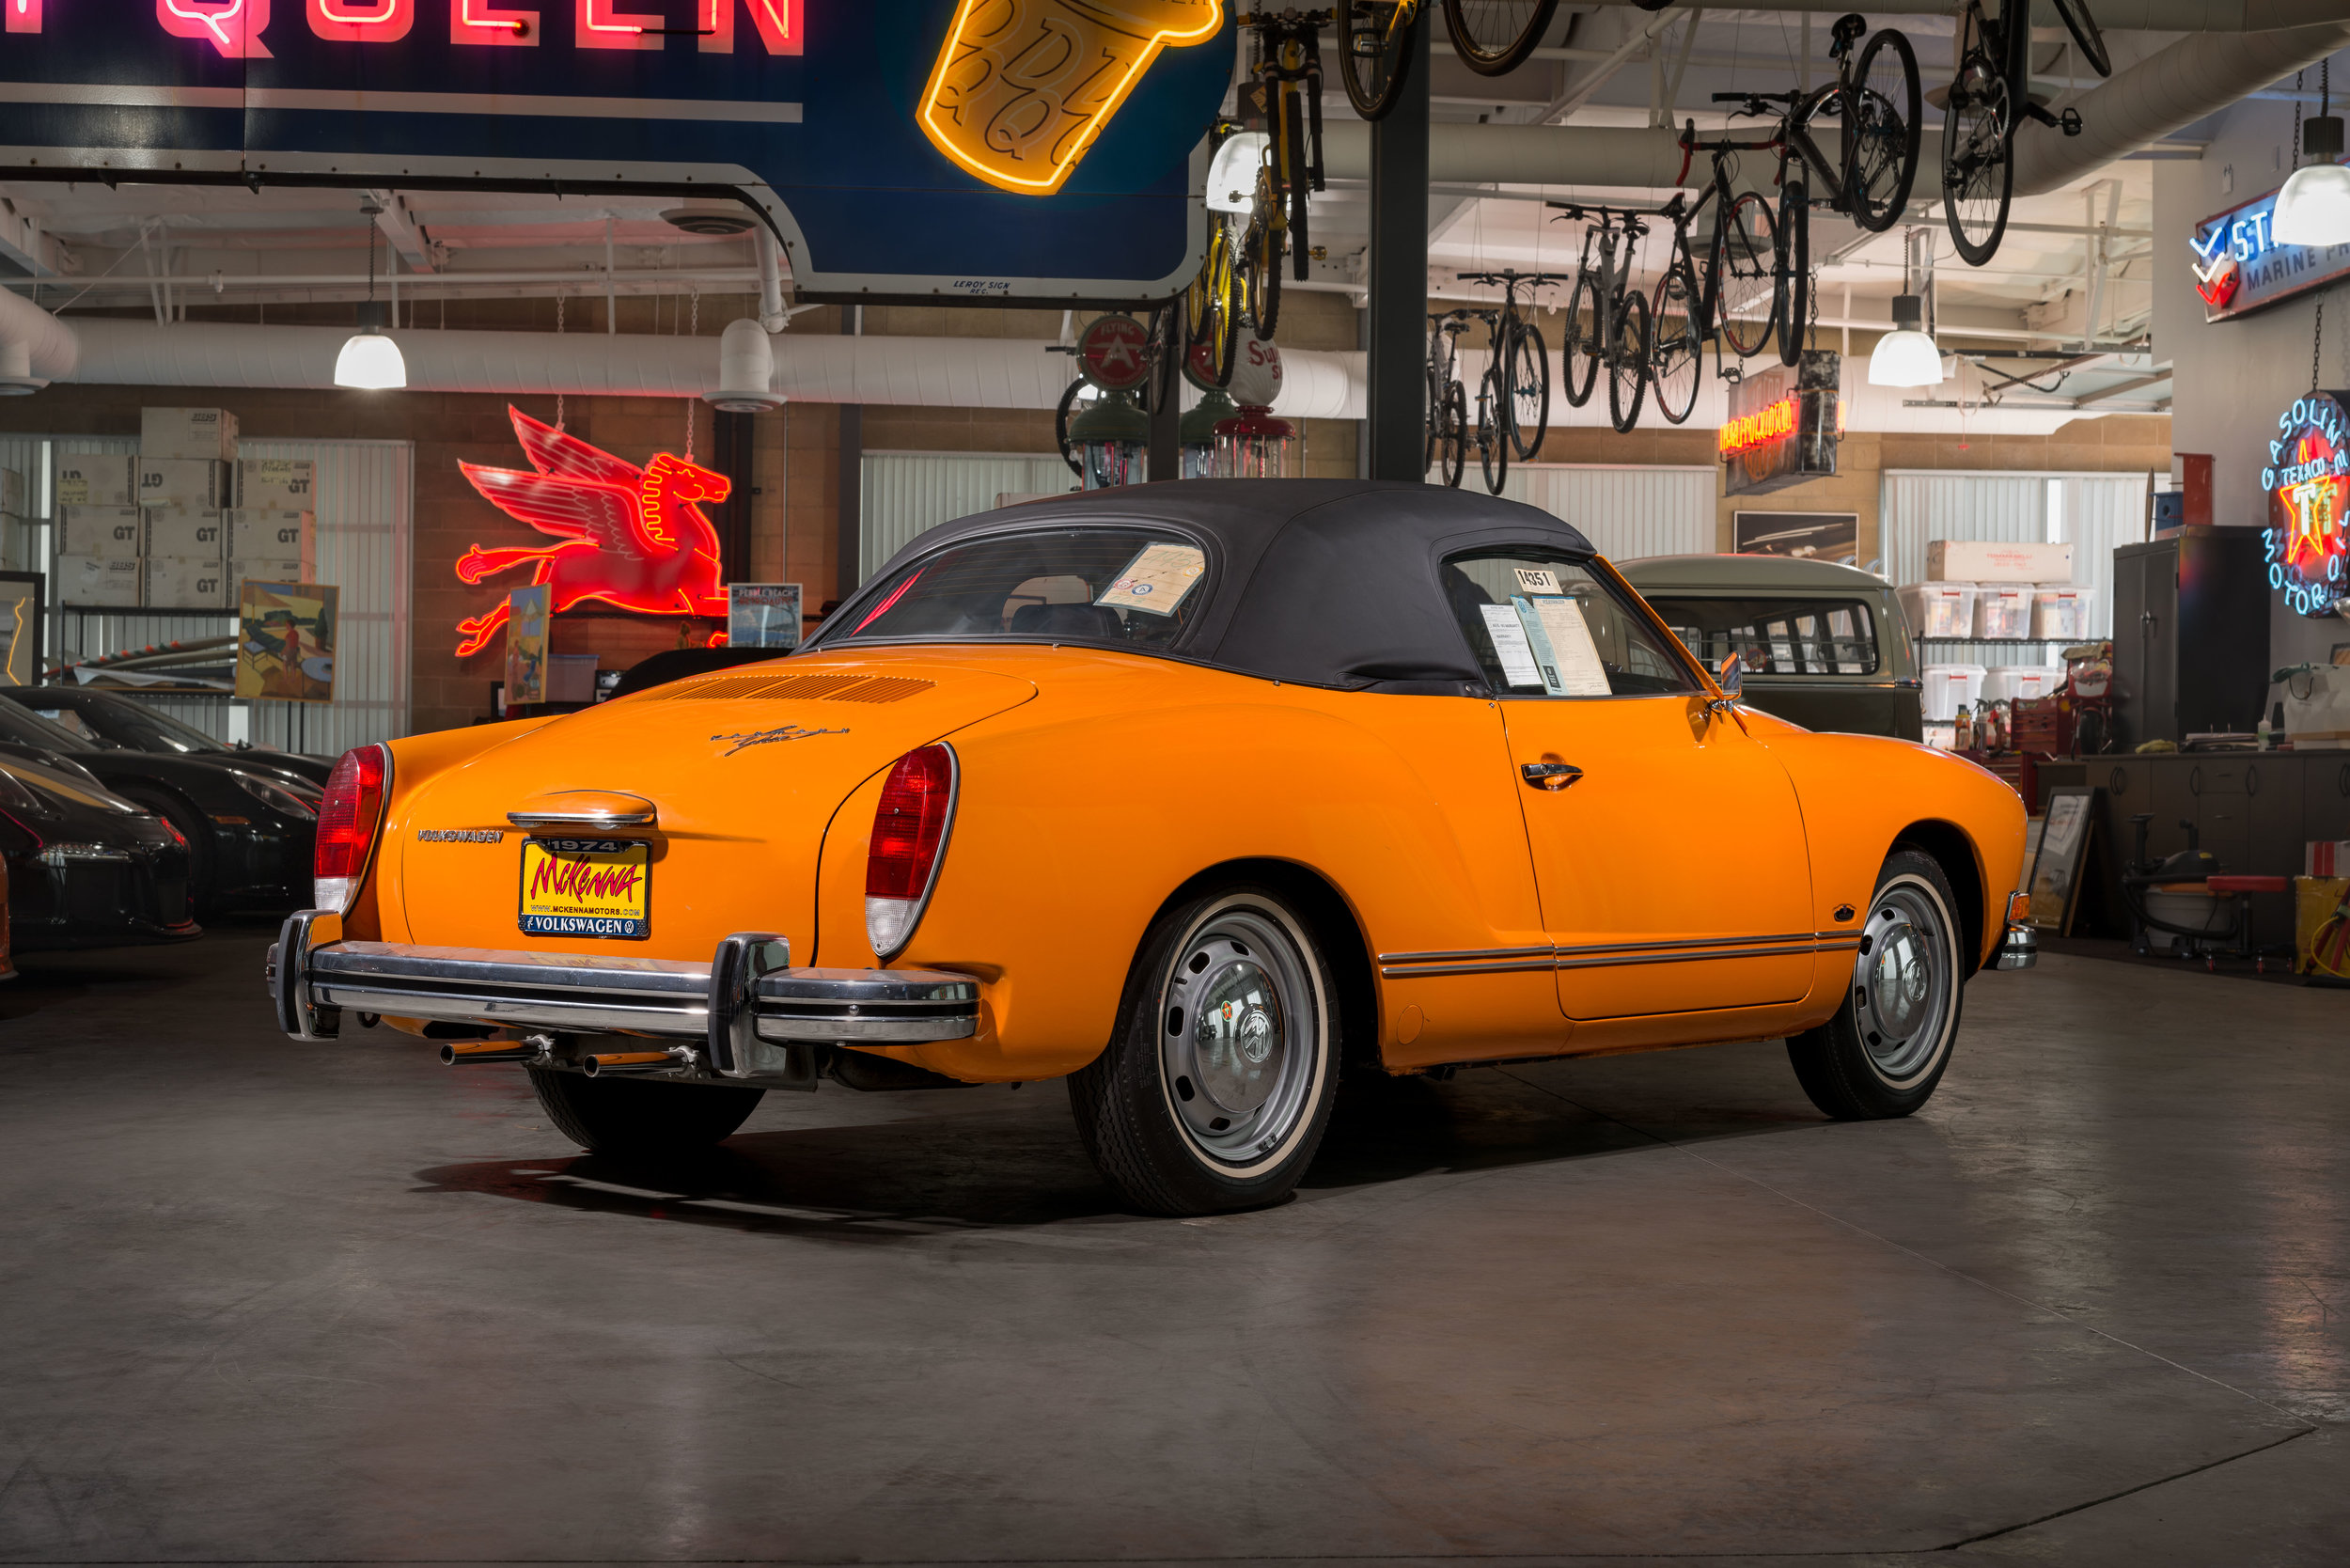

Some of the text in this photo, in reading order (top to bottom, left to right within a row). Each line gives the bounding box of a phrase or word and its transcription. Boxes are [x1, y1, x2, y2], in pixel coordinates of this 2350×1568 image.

[2247, 247, 2316, 291] MARINE
[1100, 322, 1135, 337] FLYING
[2281, 457, 2326, 487] TEXACO
[113, 525, 135, 541] GT
[196, 527, 218, 541] GT
[277, 528, 299, 543] GT
[196, 578, 218, 593] GT
[1517, 570, 1551, 587] 14351
[417, 829, 504, 844] VOLKSWAGEN
[552, 839, 618, 852] 1974
[530, 904, 640, 917] WWW.MCKENNAMOTORS.COM
[536, 917, 622, 933] VOLKSWAGEN
